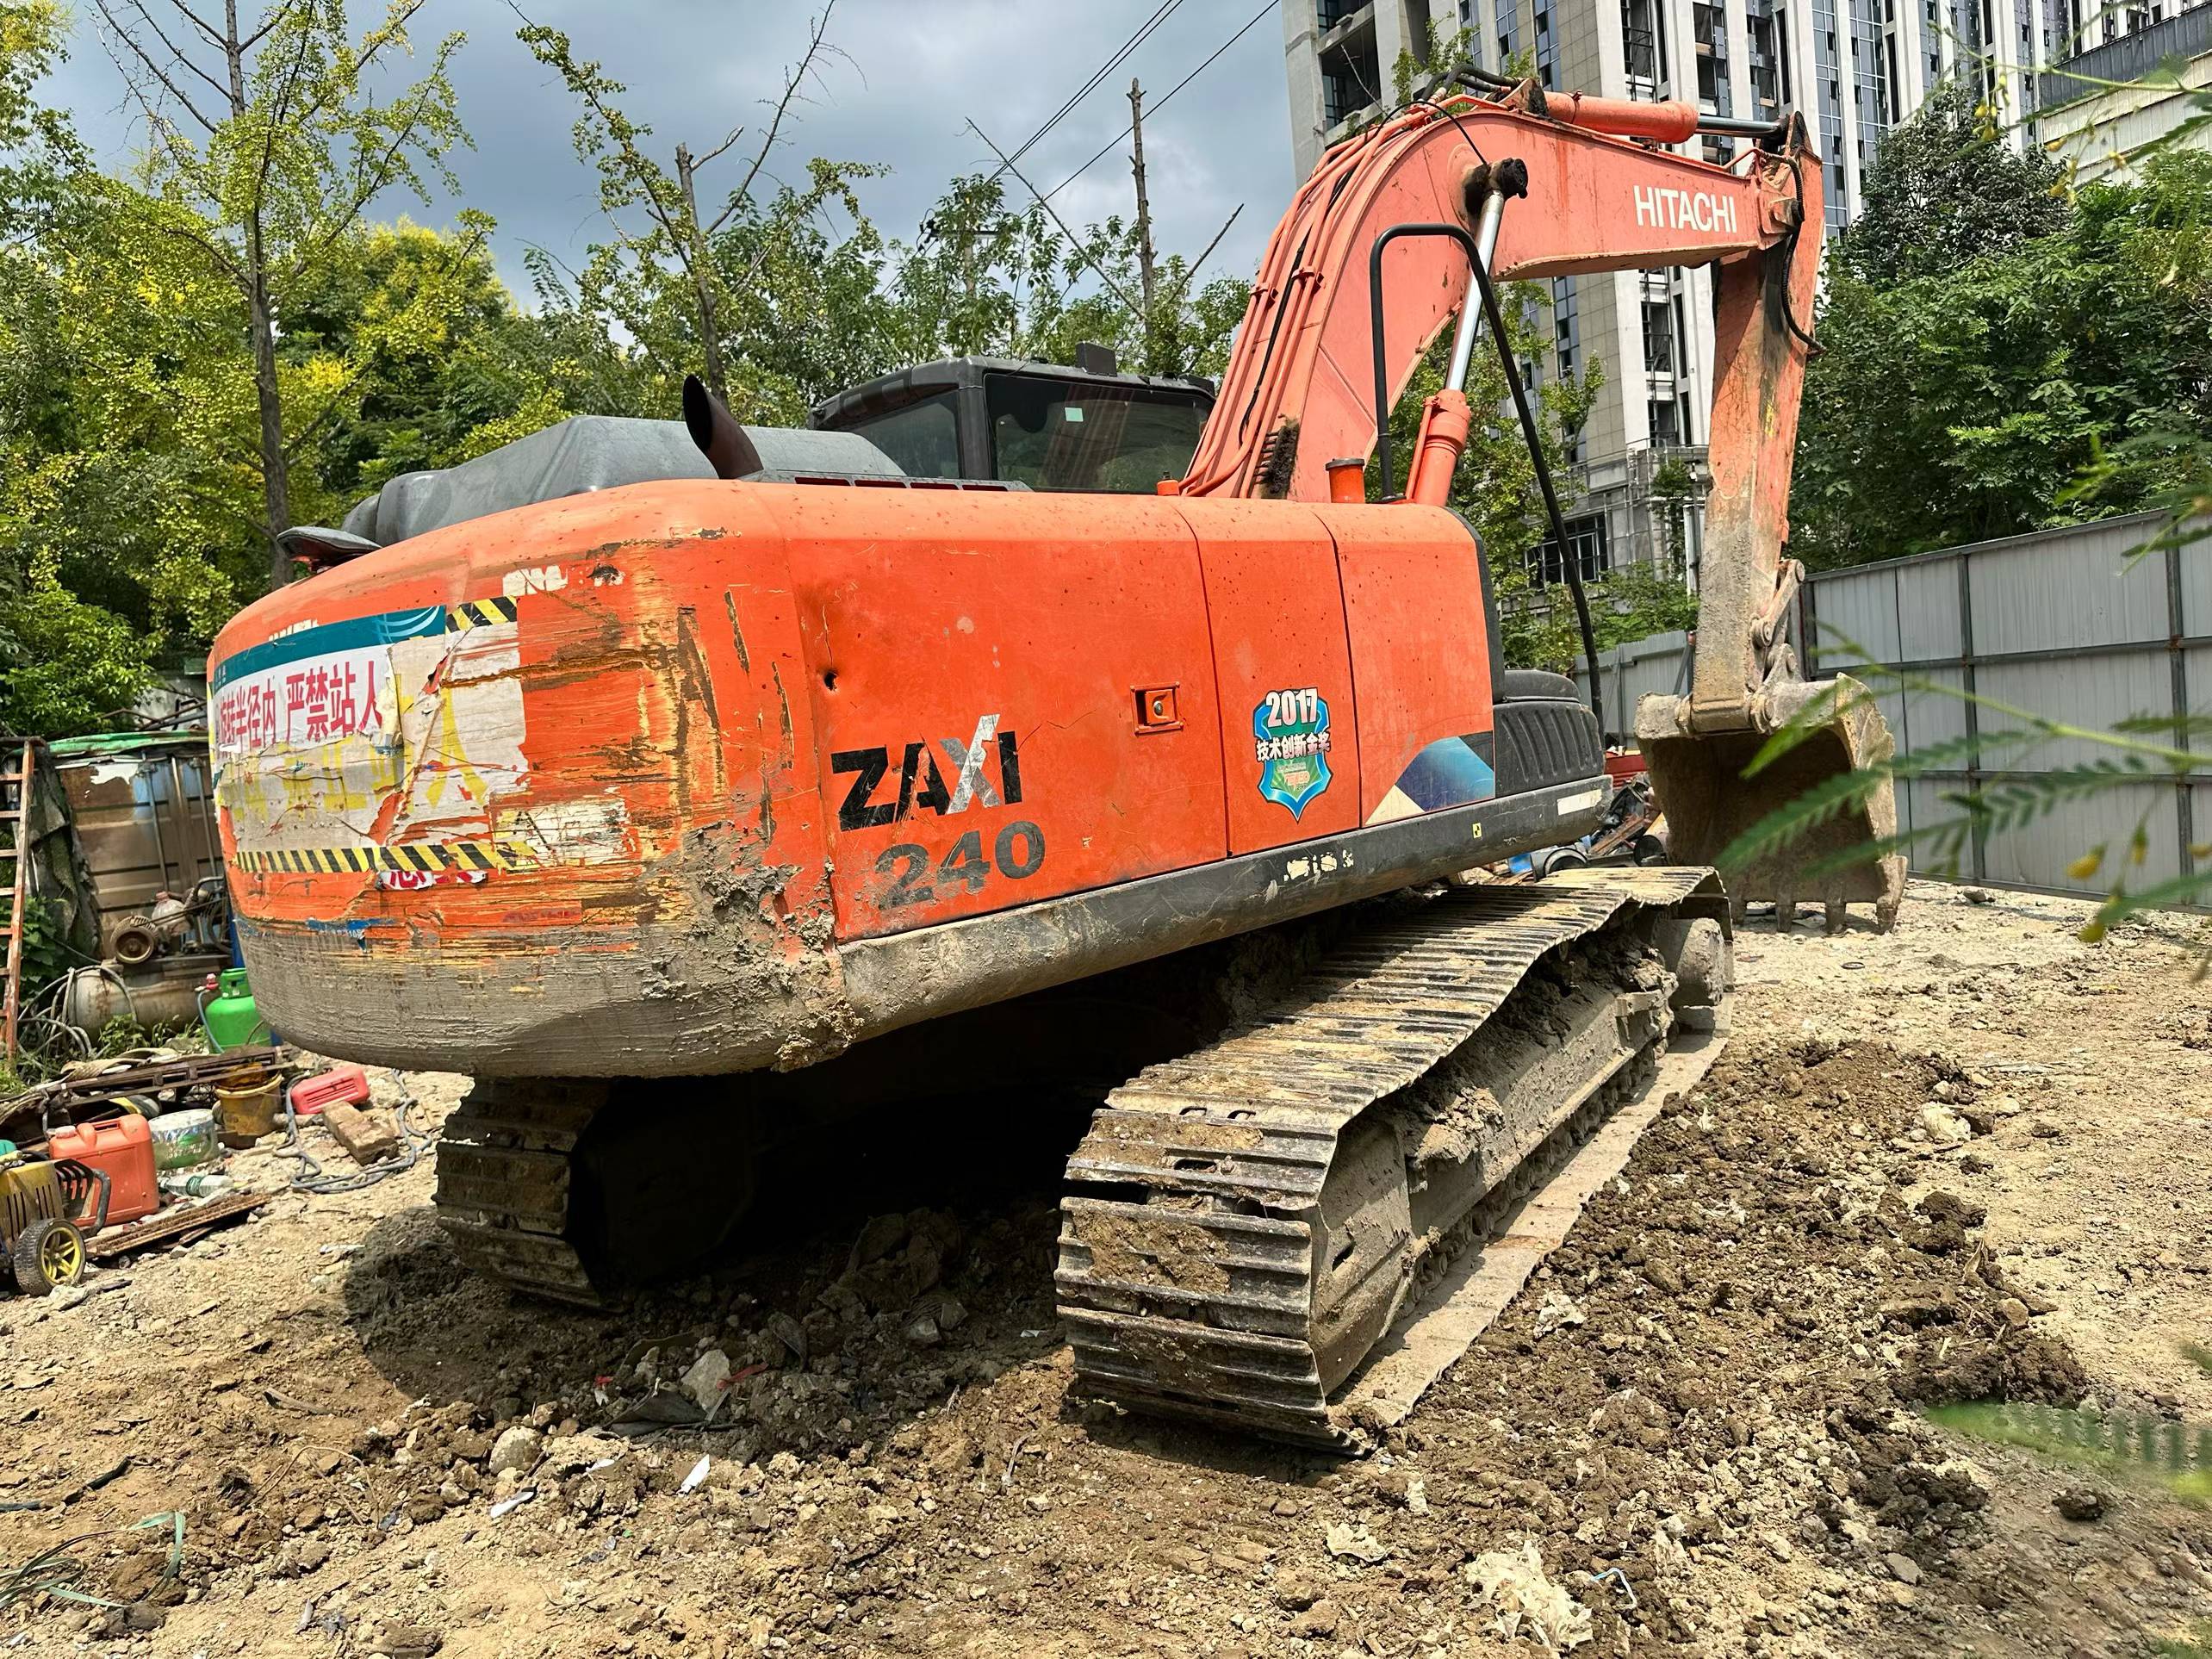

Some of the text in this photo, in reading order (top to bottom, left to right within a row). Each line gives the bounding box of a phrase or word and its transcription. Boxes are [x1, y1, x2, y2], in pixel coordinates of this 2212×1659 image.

[1634, 185, 1737, 233] HITACHI
[286, 661, 382, 745] 严禁站人
[1265, 688, 1318, 728] 2017
[830, 713, 1023, 833] ZAXI
[1256, 731, 1331, 761] 技术创新金奖
[875, 820, 1046, 910] 240
